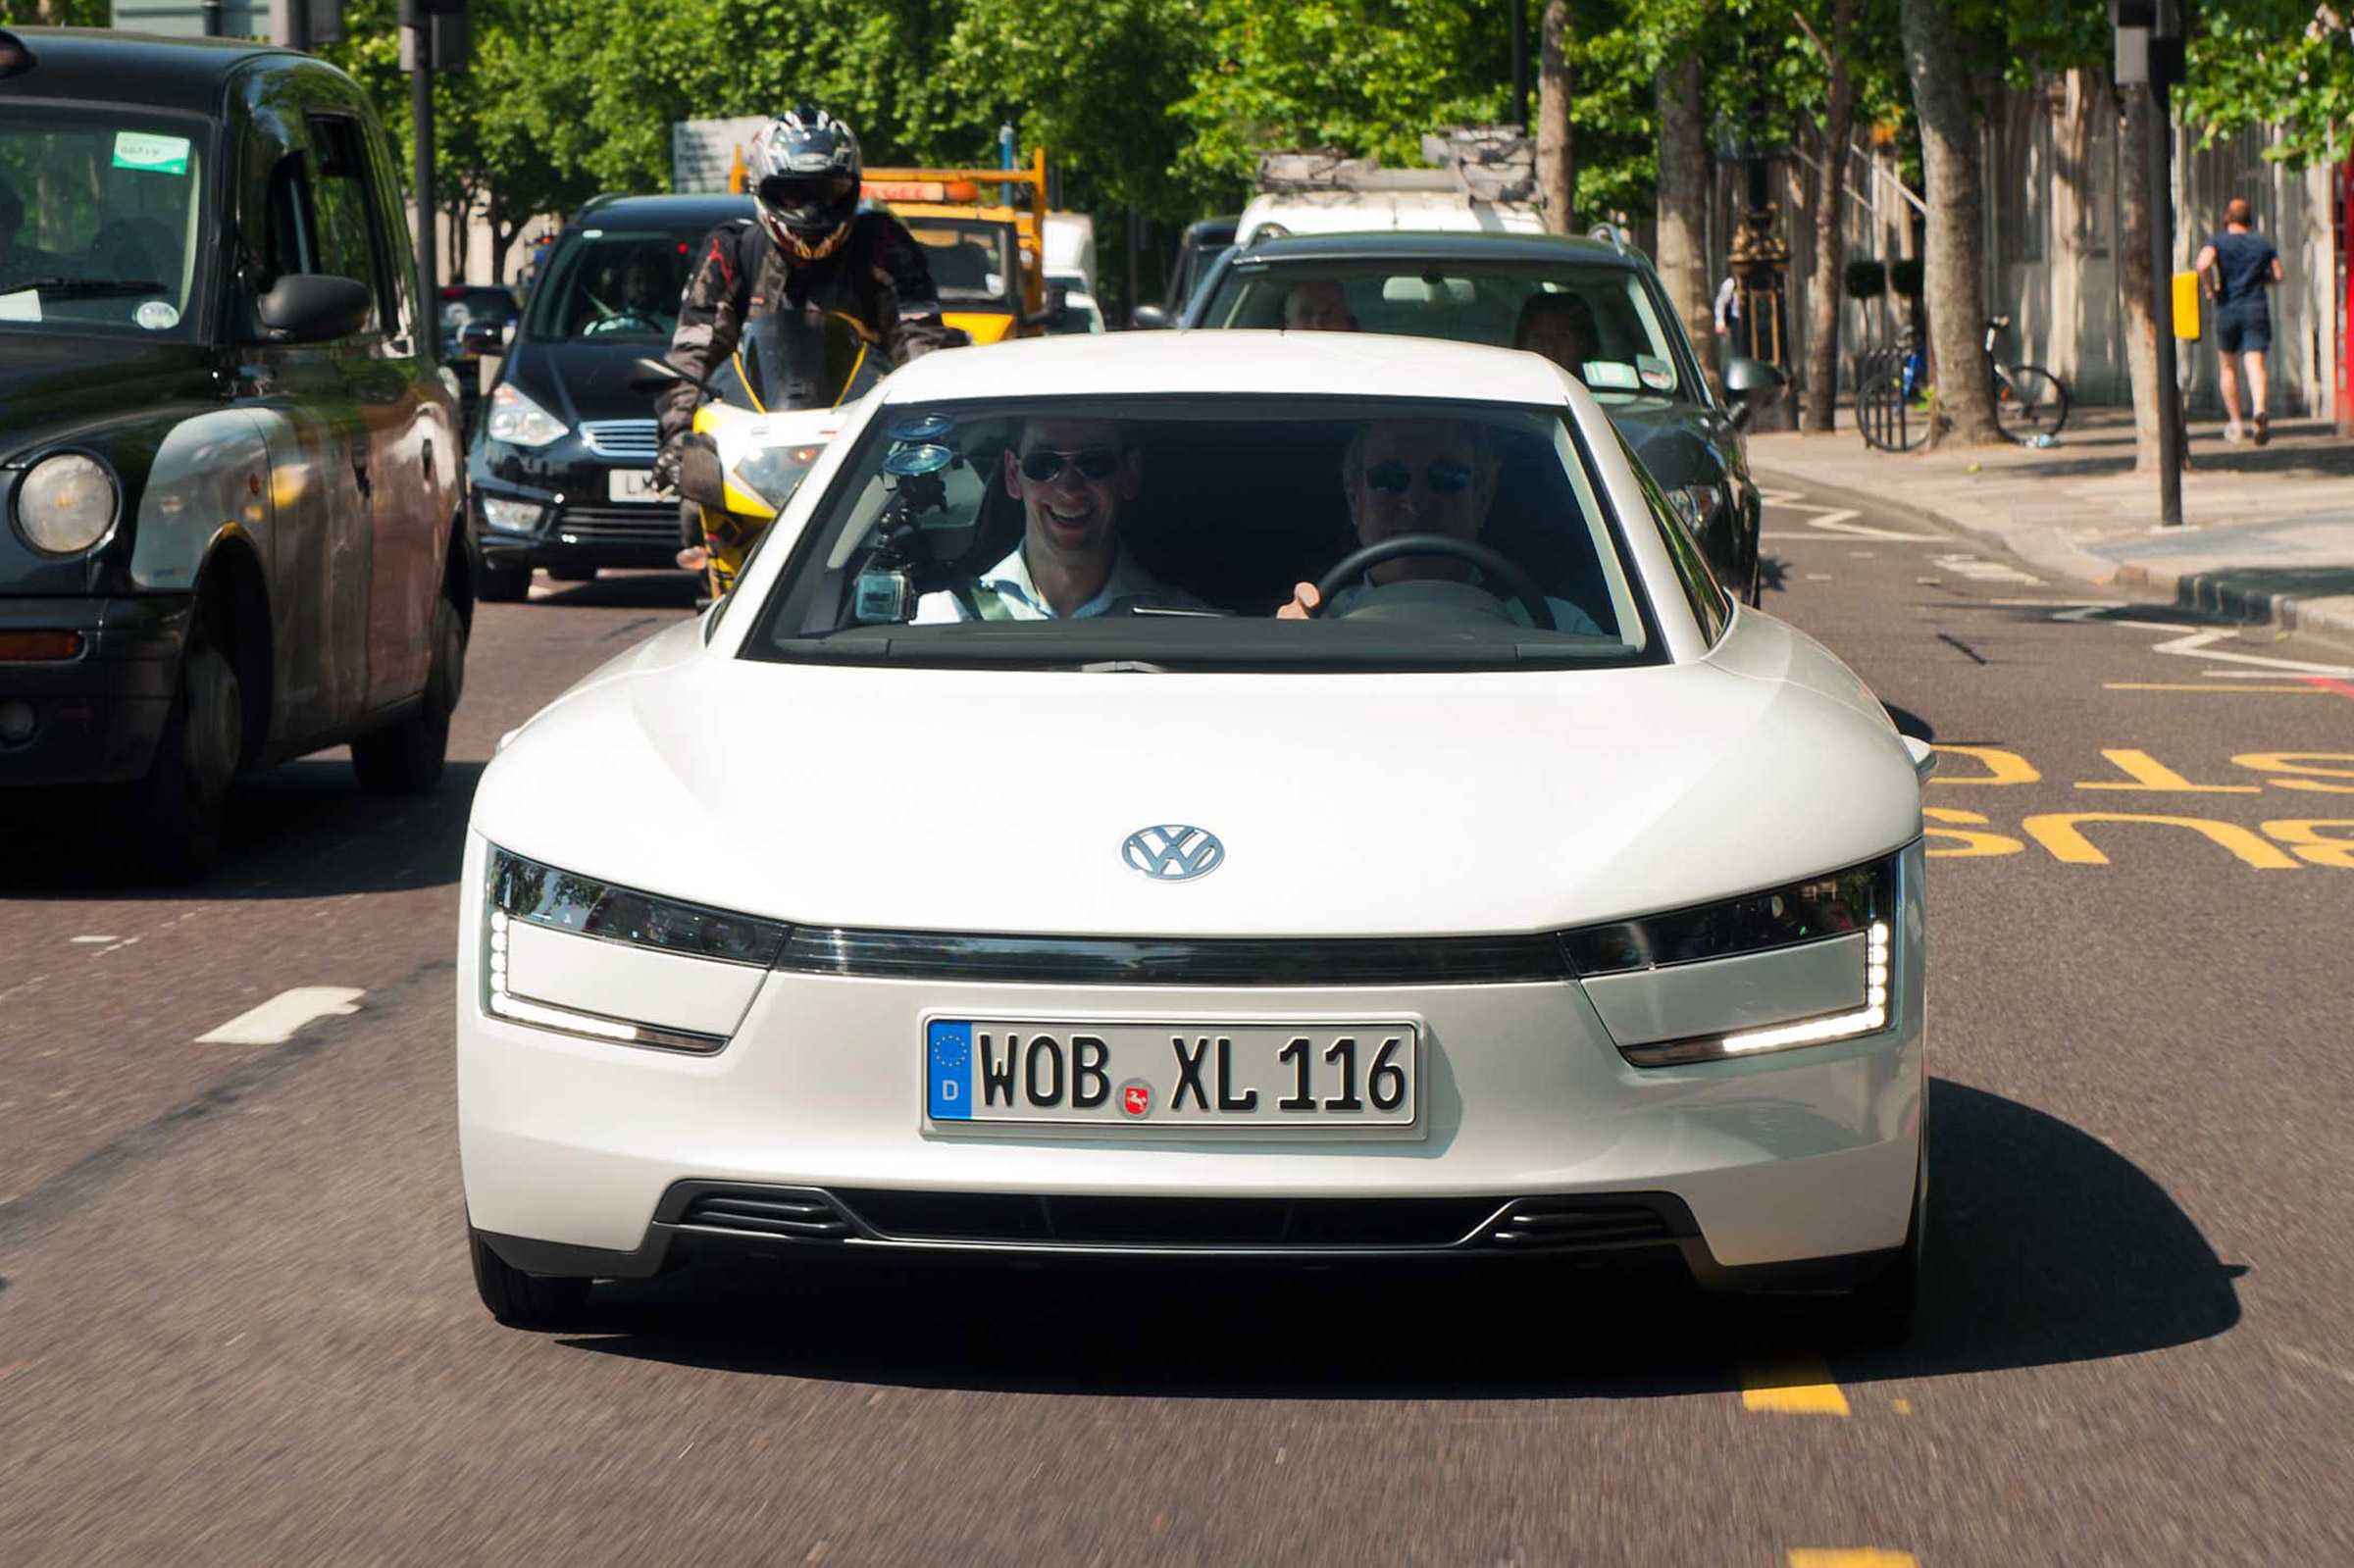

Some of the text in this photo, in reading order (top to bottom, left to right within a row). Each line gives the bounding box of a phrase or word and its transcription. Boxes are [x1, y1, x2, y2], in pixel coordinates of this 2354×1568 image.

[942, 1080, 959, 1101] D
[979, 1034, 1406, 1110] WOB XL 116
